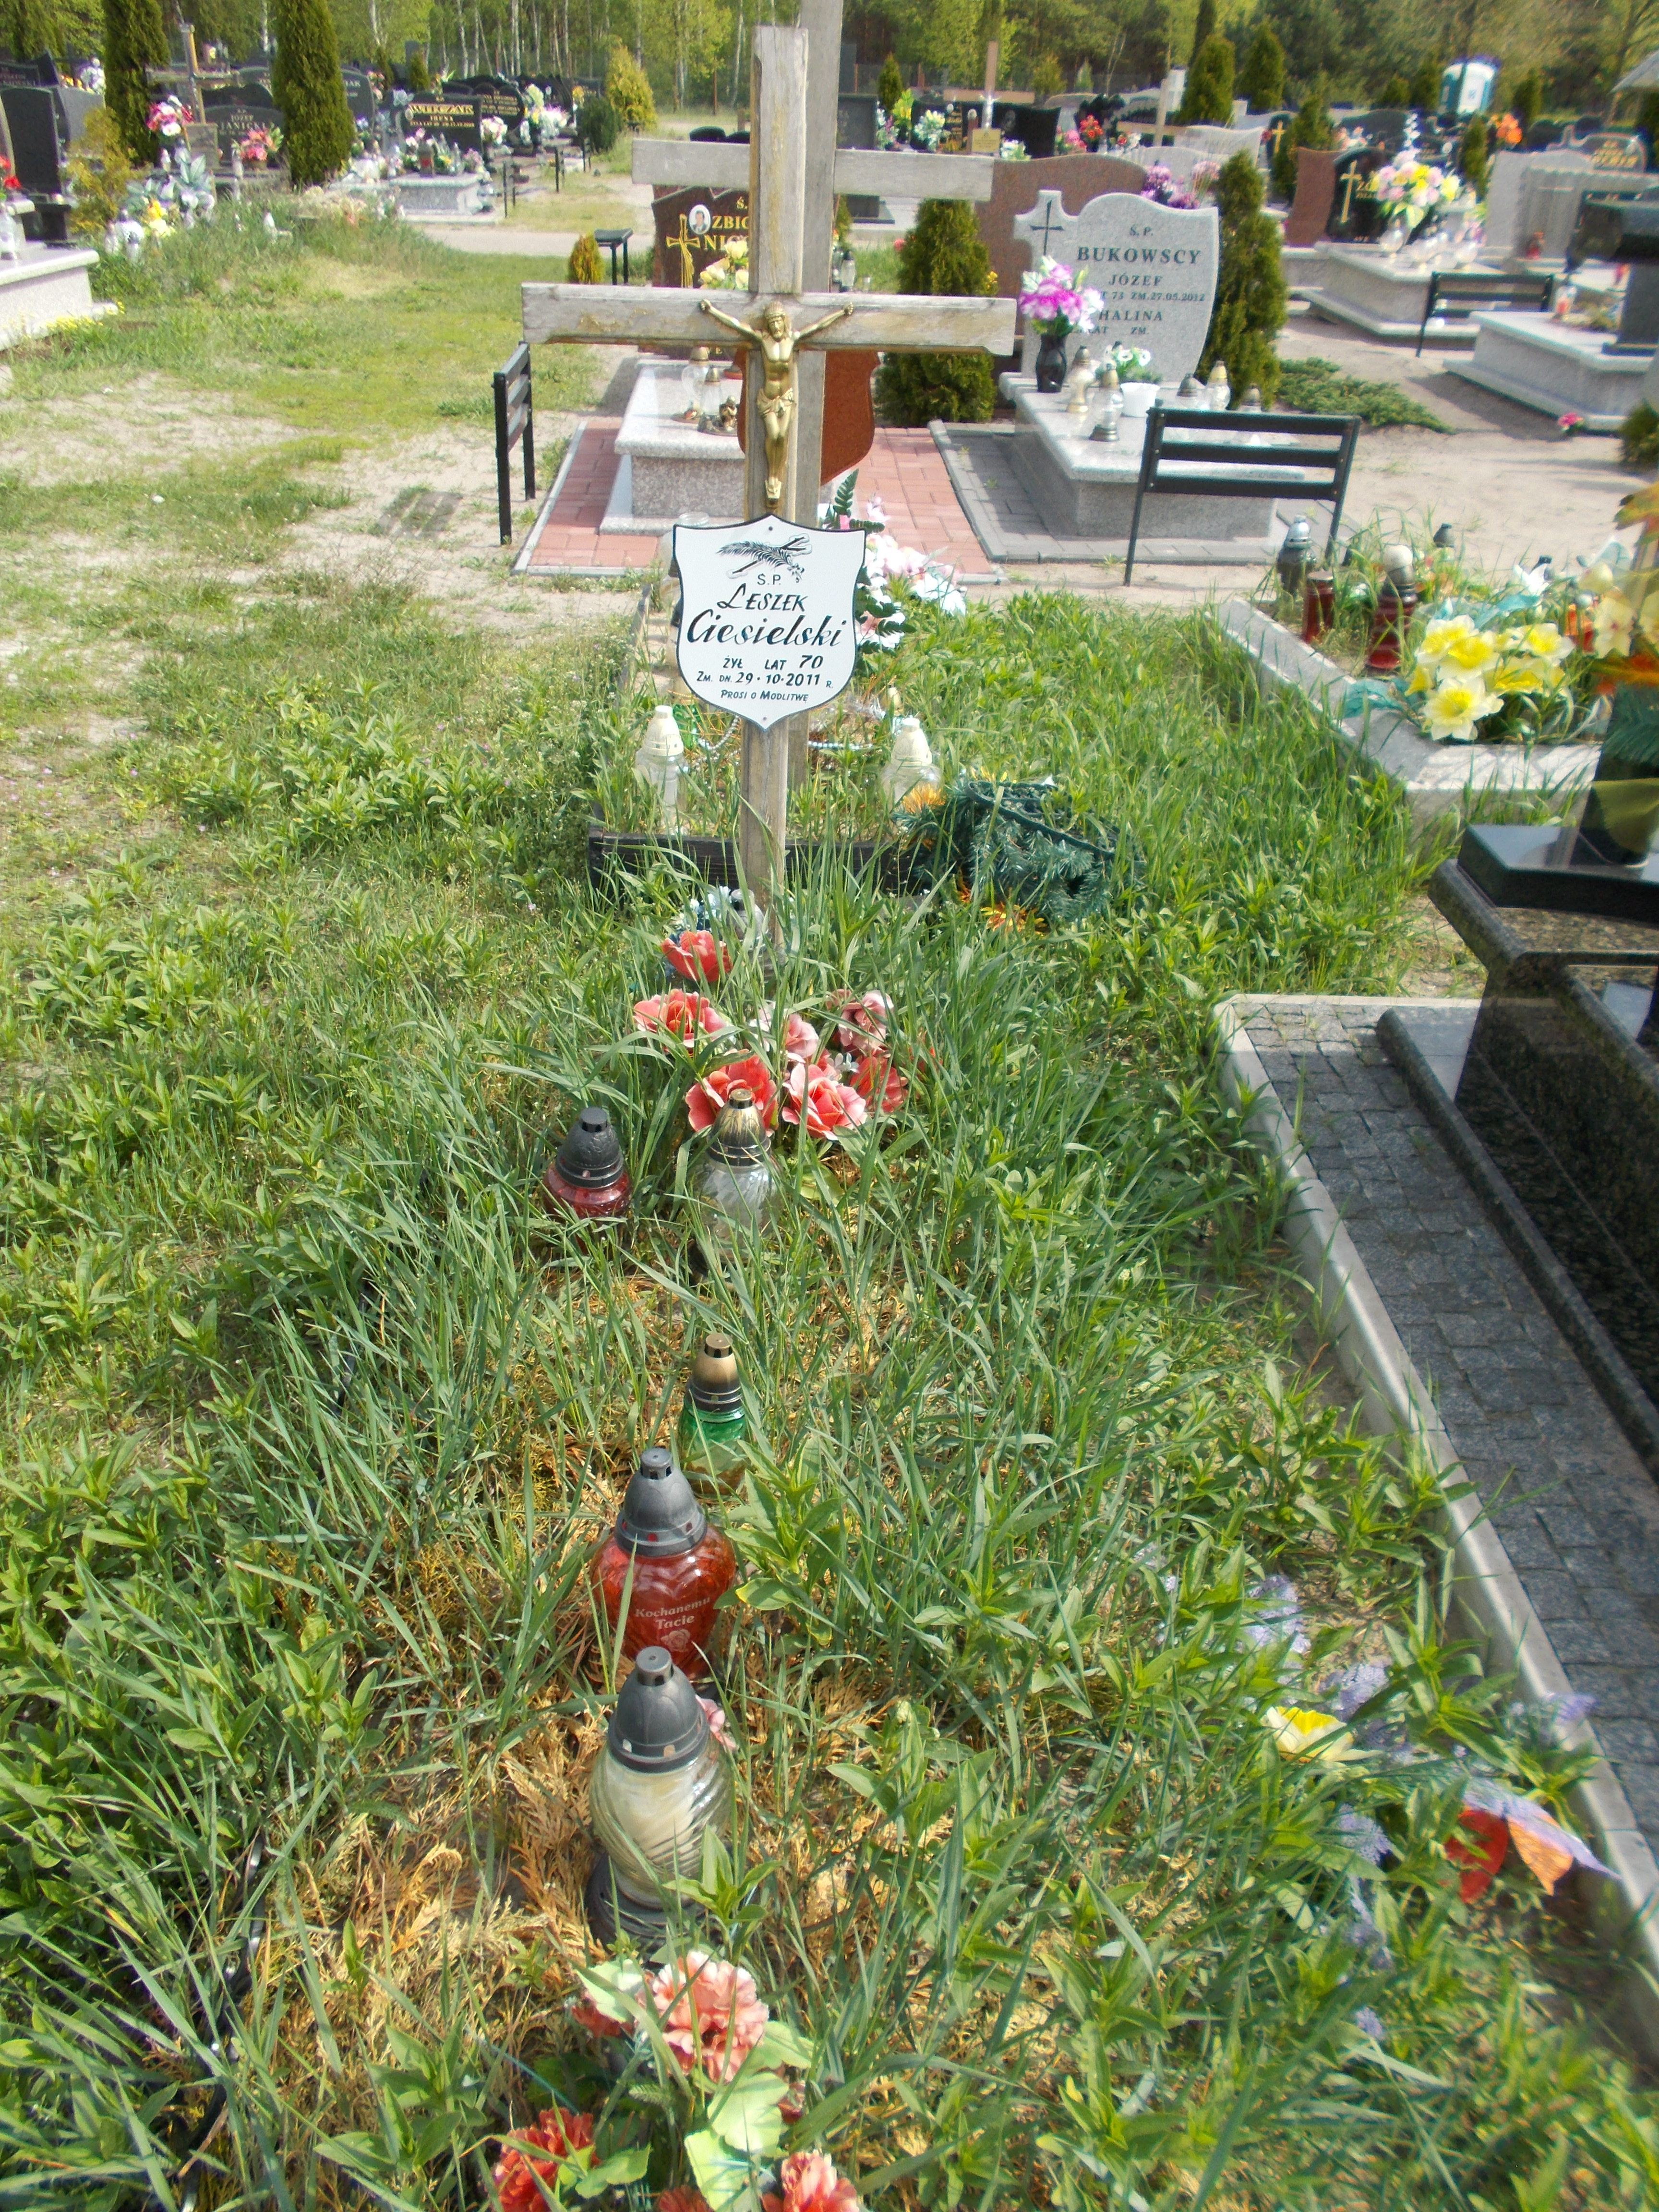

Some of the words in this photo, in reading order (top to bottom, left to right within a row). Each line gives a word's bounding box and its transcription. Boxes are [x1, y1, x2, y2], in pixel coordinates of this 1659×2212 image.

[1077, 246, 1201, 264] BUKOWSCY
[1108, 273, 1163, 287] JÓZEF
[1098, 310, 1163, 321] HALINA
[716, 582, 808, 612] LESZEK
[686, 608, 847, 647] Ciesielski
[722, 655, 744, 669] ŻYŁ
[764, 659, 787, 671] LAT
[798, 654, 824, 669] 70
[634, 1597, 711, 1618] Kochanemu
